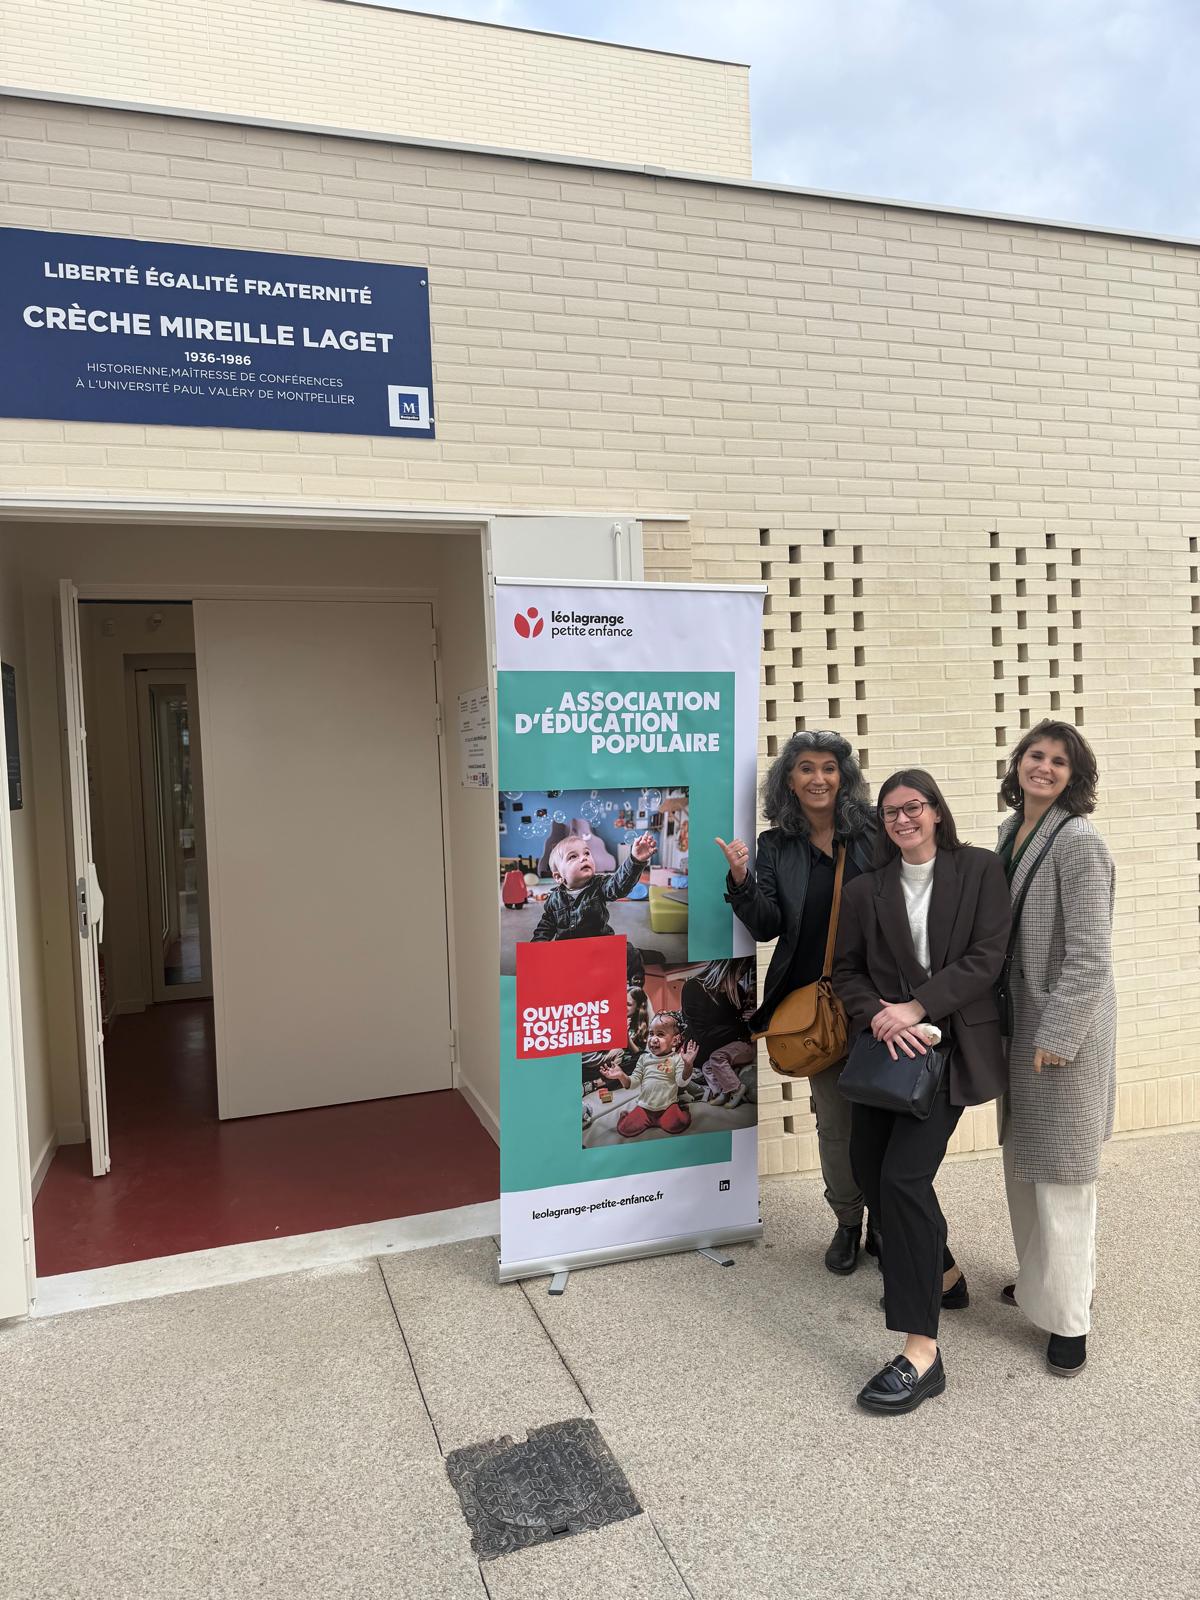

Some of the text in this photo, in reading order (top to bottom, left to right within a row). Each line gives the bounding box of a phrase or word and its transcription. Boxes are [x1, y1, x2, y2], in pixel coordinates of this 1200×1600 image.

[44, 262, 372, 304] LIBERTÉ ÉGALITÉ FRATERNITÉ
[23, 303, 393, 353] CRÈCHE MIREILLE LAGET
[184, 351, 252, 366] 1936-1986
[75, 376, 355, 405] À L'UNIVERSITÉ PAUL VALÉRY DE MONTPELLIER
[240, 372, 256, 382] DE
[259, 372, 344, 387] CONFÉRENCES
[402, 402, 417, 414] M
[571, 611, 624, 627] lagrange
[551, 625, 633, 639] petite enfance
[558, 691, 720, 712] ASSOCIATION
[515, 707, 678, 734] D'ÉDUCATION
[591, 733, 720, 754] POPULAIRE
[523, 1000, 610, 1022] OUVRONS
[523, 1014, 600, 1037] TOUS LES
[523, 1028, 612, 1052] POSSIBLES
[532, 1191, 664, 1220] leolagrange-petite-enfance.fr
